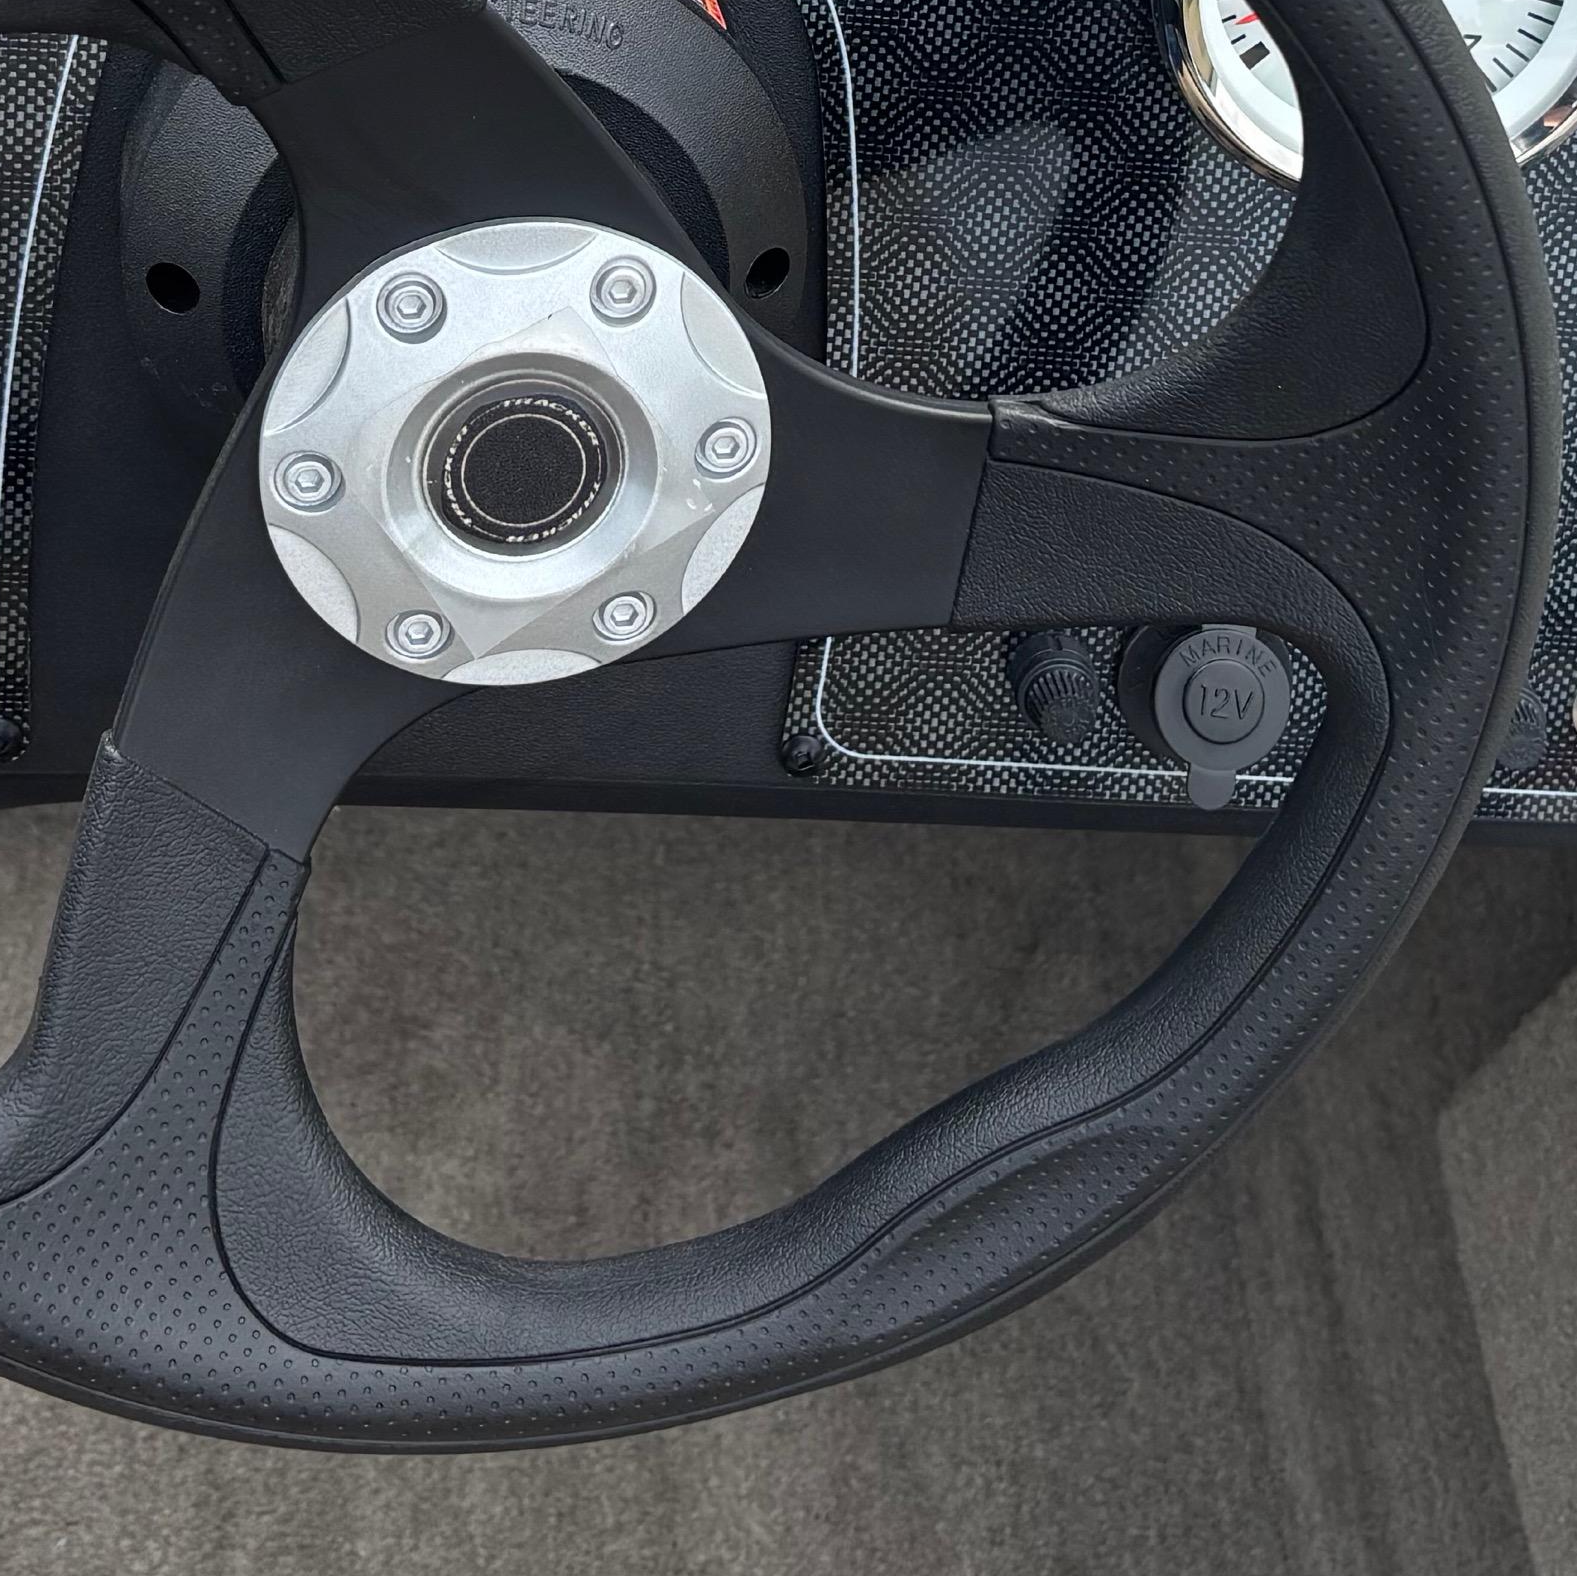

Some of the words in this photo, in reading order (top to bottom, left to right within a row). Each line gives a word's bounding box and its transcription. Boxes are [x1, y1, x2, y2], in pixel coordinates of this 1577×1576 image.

[503, 397, 600, 447] TRACKER
[1178, 635, 1277, 678] MARINE
[1200, 684, 1254, 721] 12V
